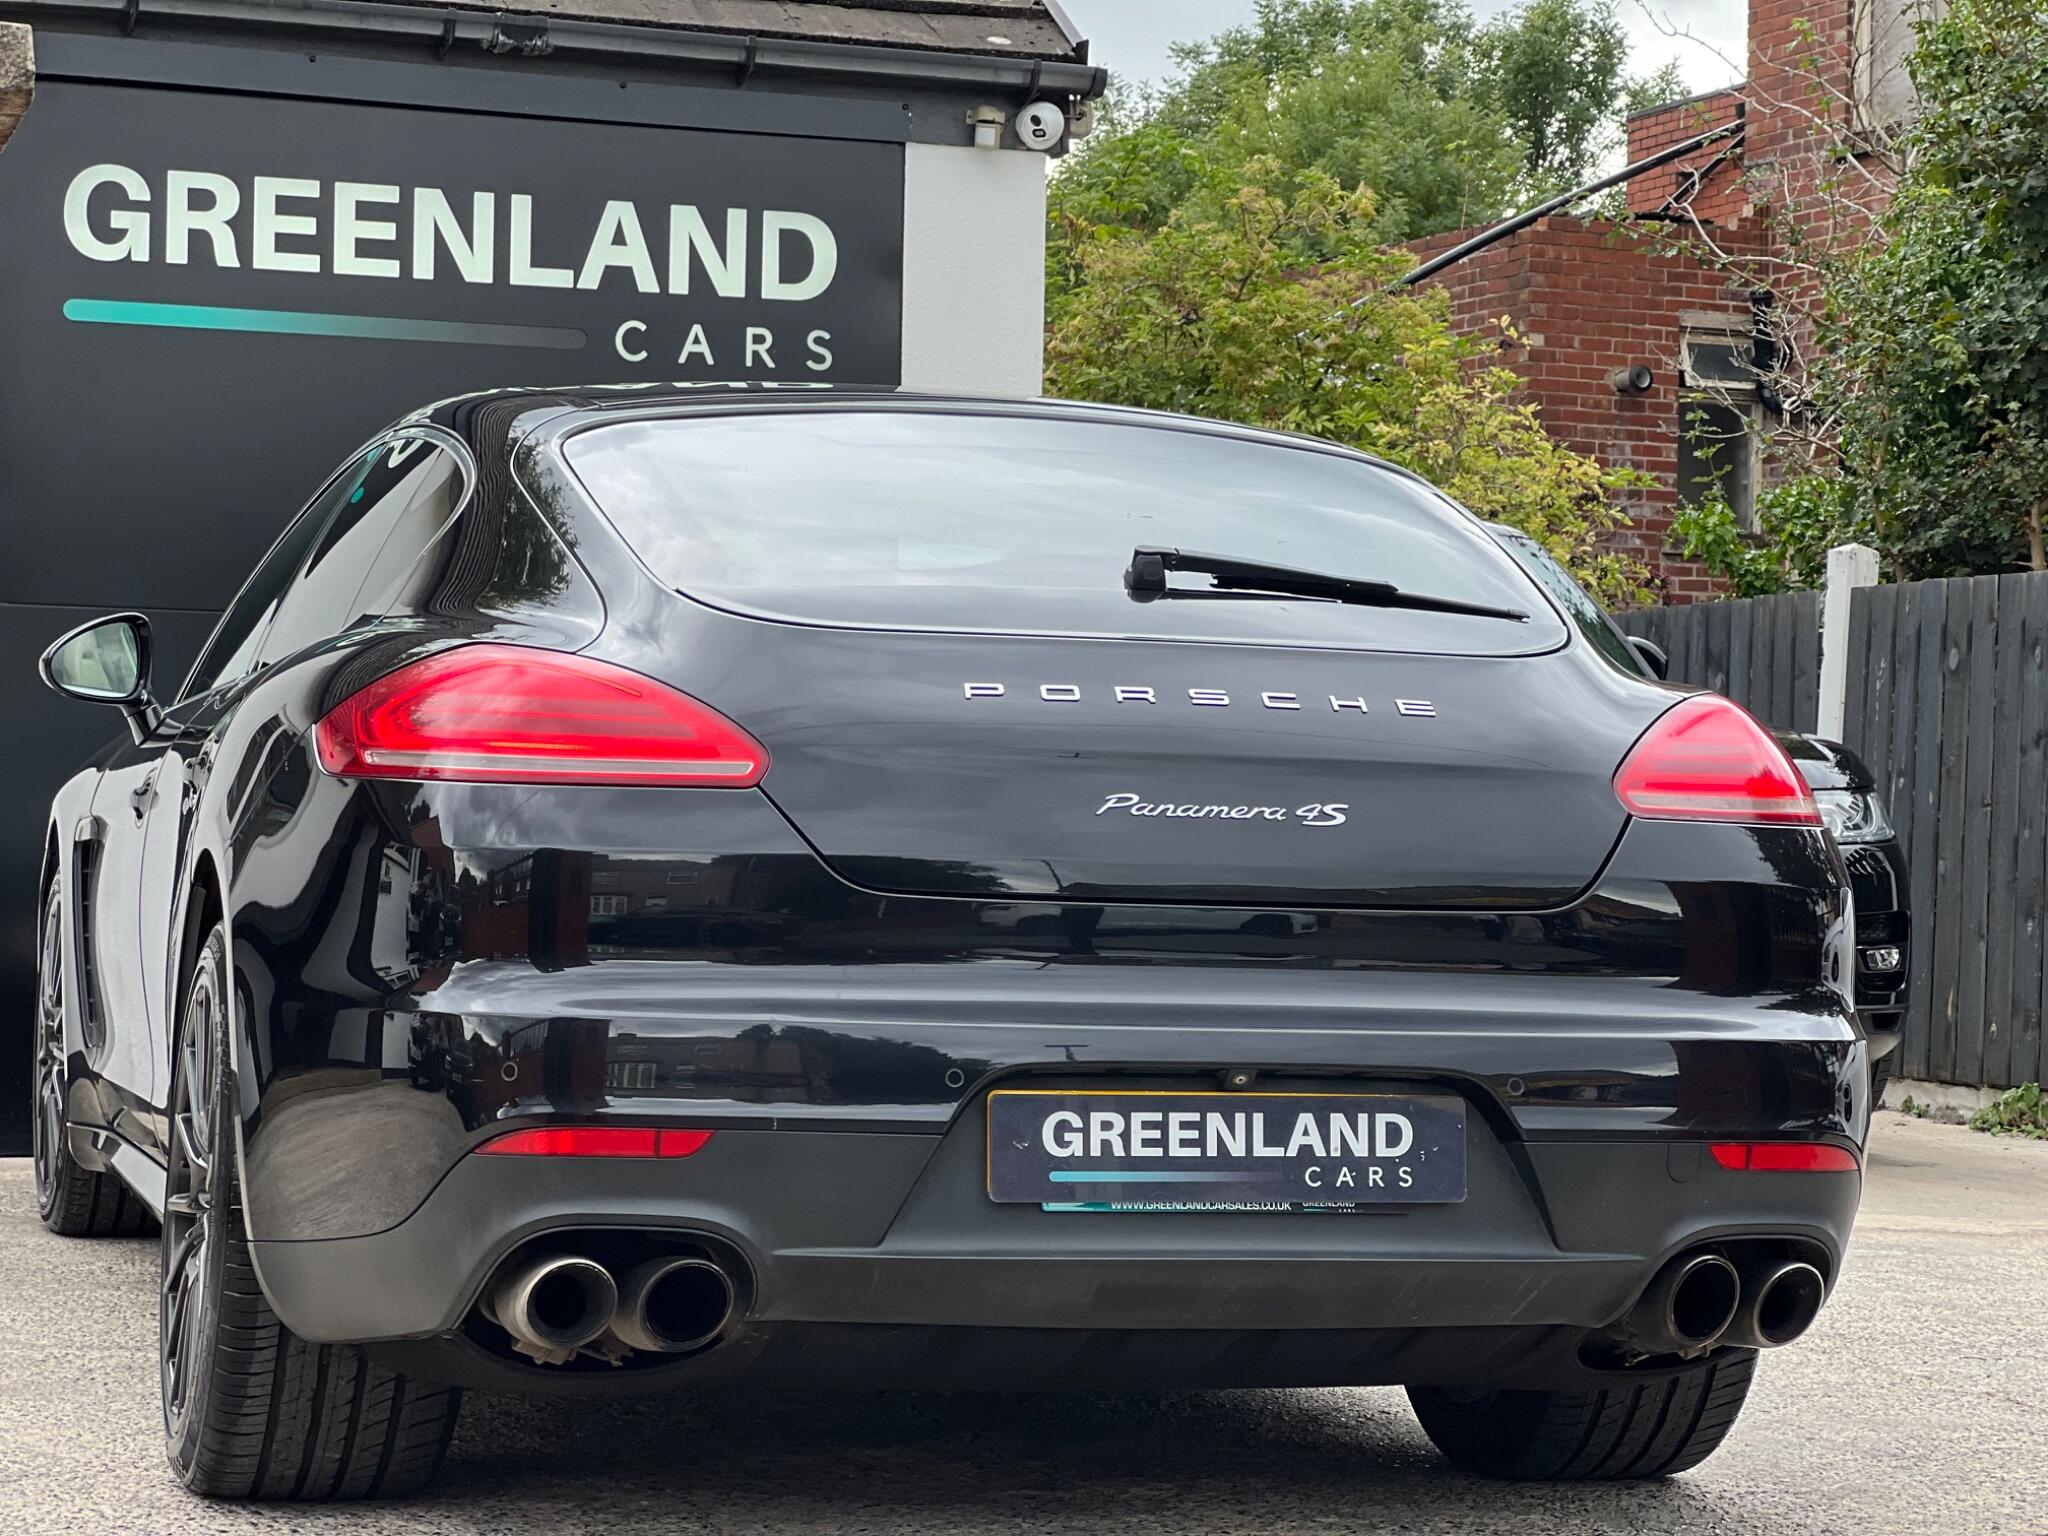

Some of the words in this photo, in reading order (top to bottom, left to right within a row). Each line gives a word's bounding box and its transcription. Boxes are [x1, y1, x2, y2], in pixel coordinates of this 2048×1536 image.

[63, 163, 838, 301] GREENLAND
[615, 320, 834, 371] CARS
[963, 682, 1438, 717] PORSCHE
[1096, 792, 1287, 822] Panamera
[1294, 803, 1349, 827] 4S
[1042, 1110, 1414, 1158] GREENLAND
[1304, 1166, 1413, 1188] CARS
